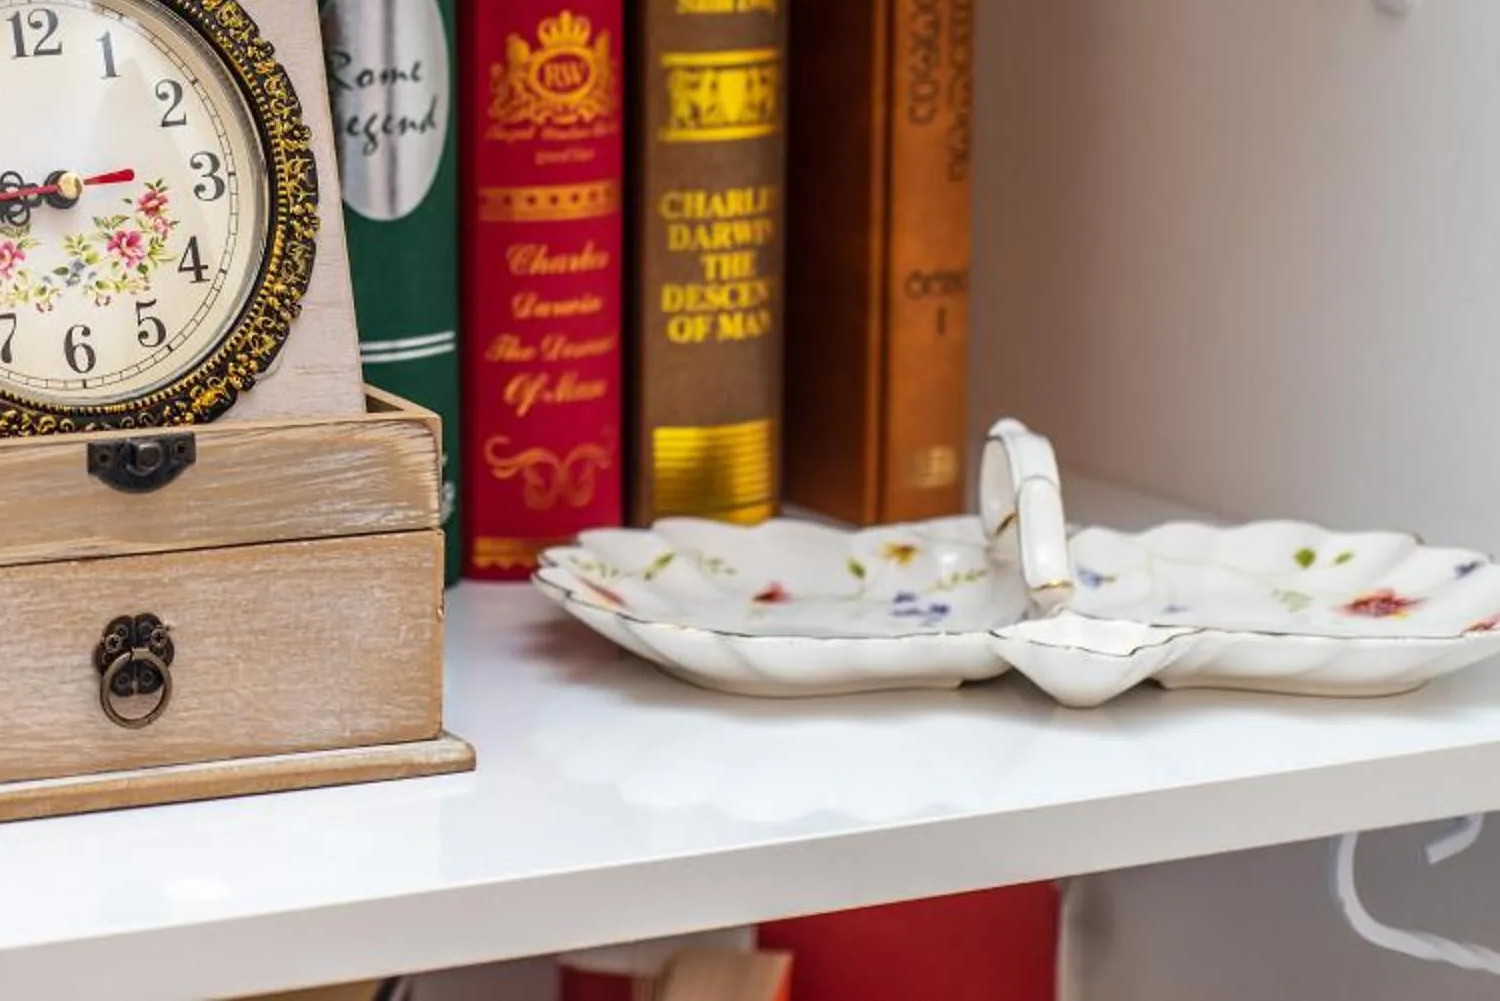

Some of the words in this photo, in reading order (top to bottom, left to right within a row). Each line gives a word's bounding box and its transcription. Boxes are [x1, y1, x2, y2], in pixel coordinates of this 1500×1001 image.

[6, 7, 63, 59] 12
[95, 31, 122, 80] 1
[154, 78, 189, 129] 2
[342, 94, 439, 156] egend
[189, 151, 226, 201] 3
[177, 235, 211, 284] 4
[134, 298, 167, 348] 5
[63, 323, 97, 374] 6
